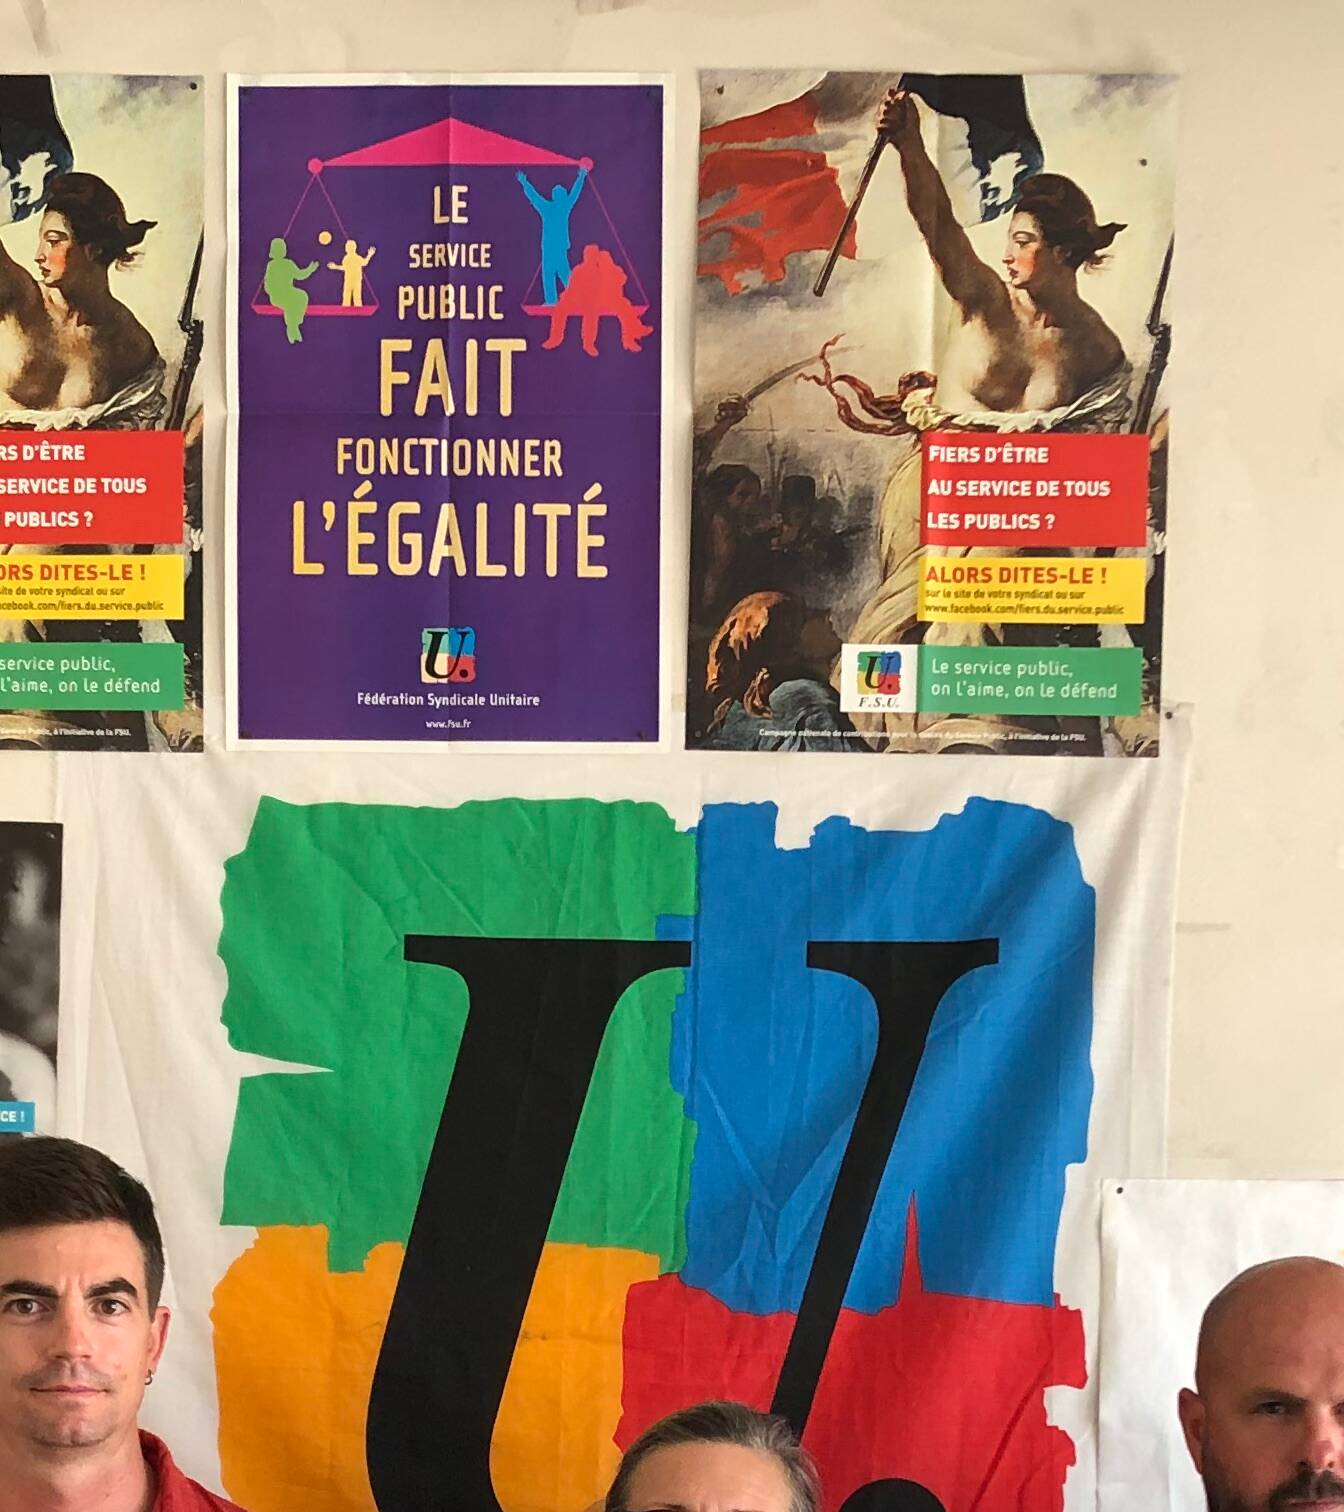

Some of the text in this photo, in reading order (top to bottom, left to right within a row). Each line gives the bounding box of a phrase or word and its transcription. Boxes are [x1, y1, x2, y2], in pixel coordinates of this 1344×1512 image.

[433, 185, 469, 224] LE
[409, 242, 491, 269] SERVICE
[398, 284, 505, 320] PUBLIC
[380, 338, 527, 416] FAIT
[23, 440, 85, 461] D'ÊTRE
[336, 437, 564, 477] FONCTIONNER
[929, 443, 1049, 463] FIERS D'ÊTRE
[73, 478, 97, 494] DE
[101, 478, 147, 494] TOUS
[928, 480, 1111, 496] AU SERVICE DE TOUS
[4, 511, 79, 527] PUBLICS
[927, 512, 1041, 529] LES PUBLICS
[292, 480, 609, 578] L'ÉGALITÉ
[40, 564, 133, 581] DITES-LE
[926, 567, 1094, 583] ALORS DITES-LE
[15, 586, 26, 595] de
[29, 586, 53, 595] votre
[96, 587, 108, 595] ou
[110, 587, 125, 595] sur
[60, 656, 116, 675] public,
[932, 659, 1073, 678] Le service public,
[1, 677, 53, 694] l'aime,
[58, 681, 78, 692] on
[84, 679, 98, 692] le
[105, 678, 160, 693] défend
[931, 682, 1118, 699] on l'aime, on le défend
[357, 692, 540, 709] Fédération Syndicale Unitaire
[425, 718, 471, 729] www.fsu.fr
